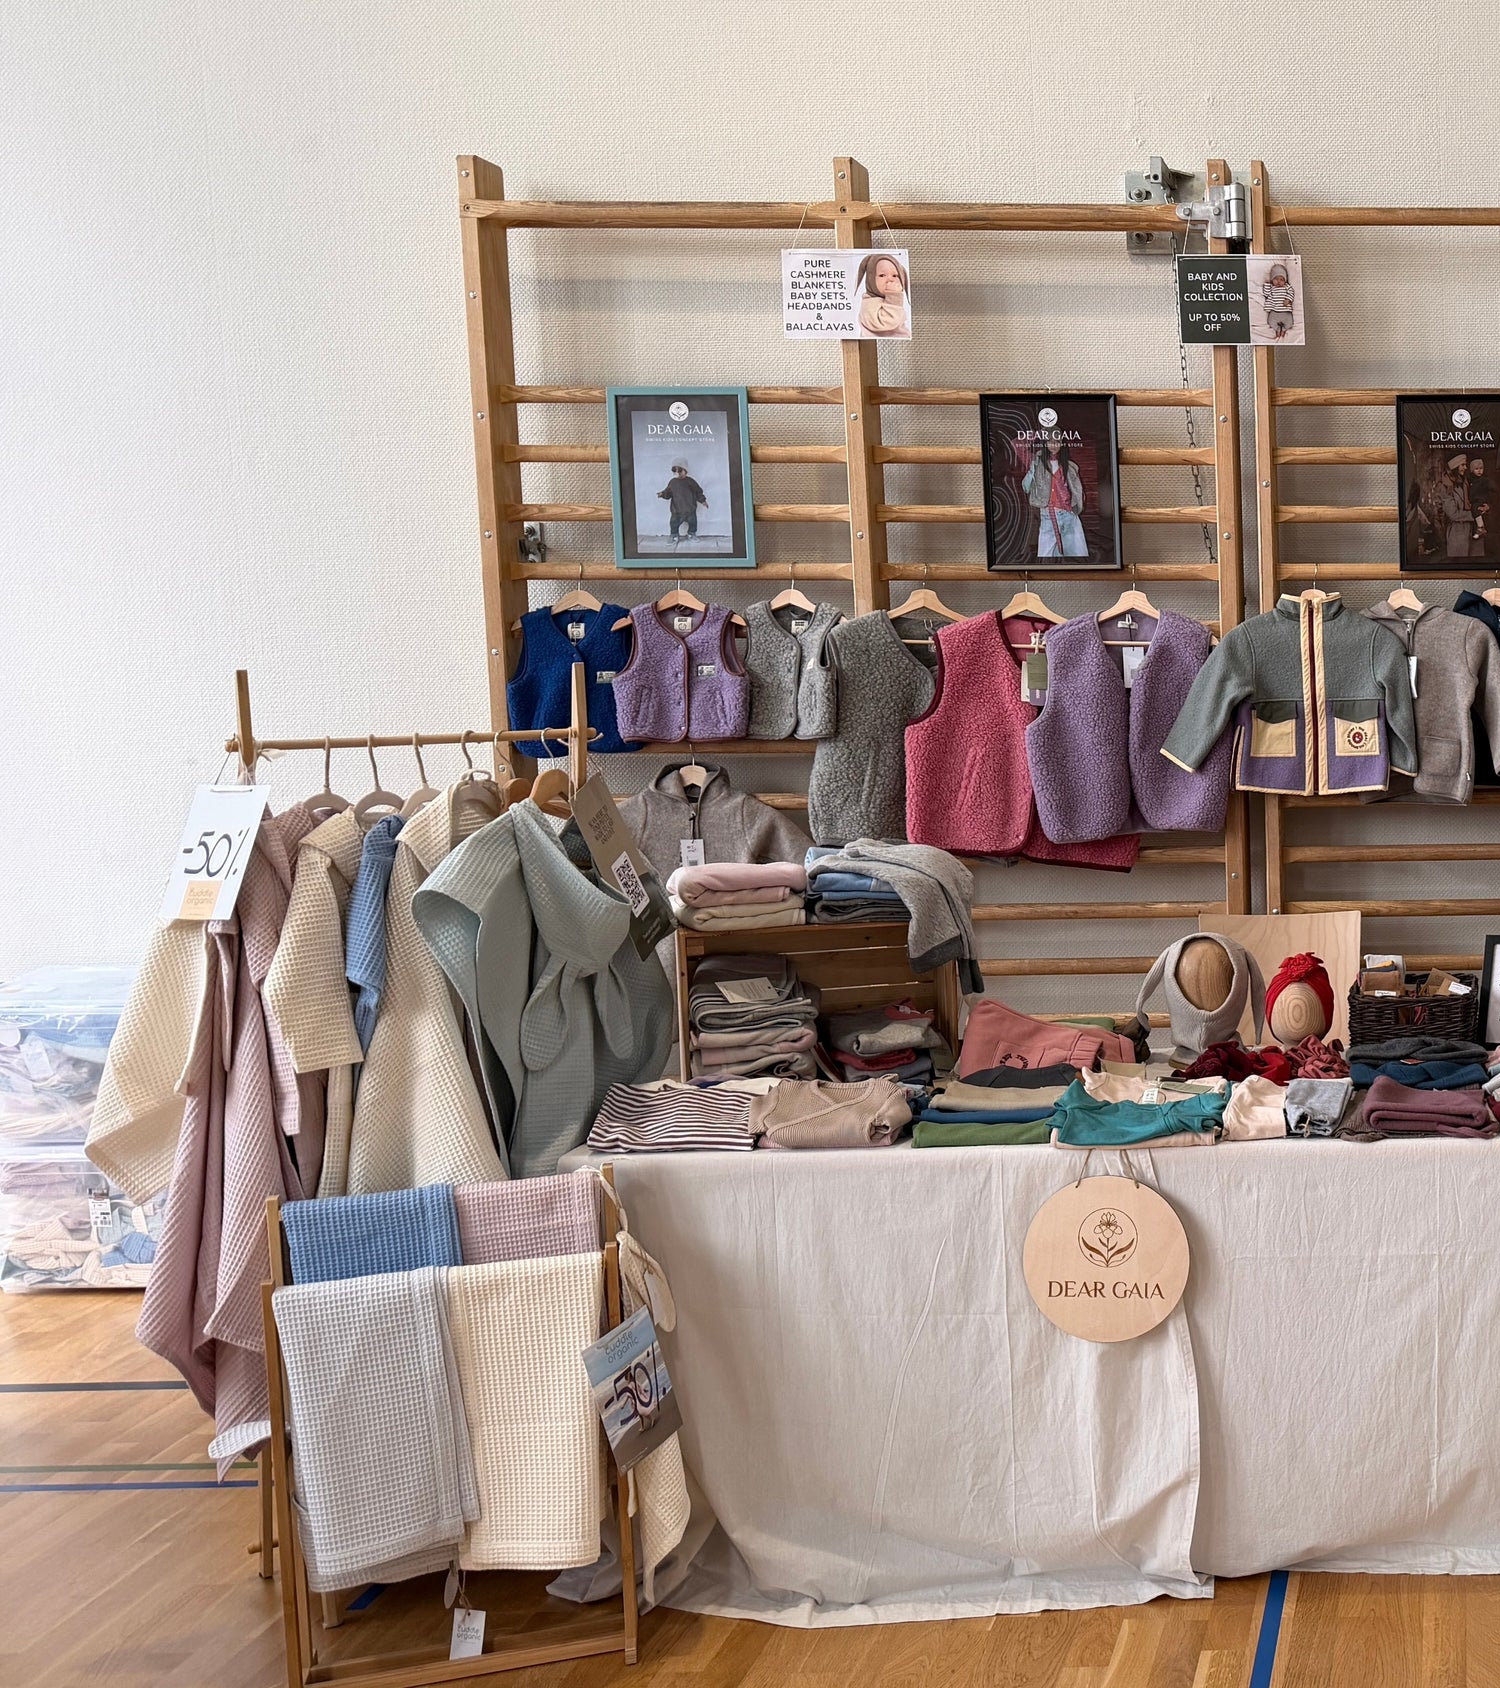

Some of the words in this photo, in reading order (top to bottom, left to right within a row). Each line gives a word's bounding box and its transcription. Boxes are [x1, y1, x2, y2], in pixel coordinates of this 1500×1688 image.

[804, 259, 831, 268] PURE
[790, 271, 846, 279] CASHMERE
[1188, 273, 1214, 281] BABY
[1216, 273, 1237, 281] AND
[791, 282, 847, 290] BLANKETS,
[1202, 283, 1225, 291] KIDS
[790, 292, 817, 300] BABY
[820, 292, 848, 300] SETS,
[1184, 293, 1243, 301] COLLECTION
[788, 302, 852, 311] HEADBANDS
[816, 313, 823, 321] &
[1189, 314, 1202, 322] UP
[1205, 314, 1218, 322] TO
[1221, 314, 1241, 322] 50%
[786, 323, 854, 331] BALACLAVAS
[1204, 324, 1222, 332] OFF
[648, 425, 680, 435] DEAR
[683, 424, 713, 435] GAIA
[1017, 431, 1049, 441] DEAR
[1052, 430, 1082, 441] GAIA
[1431, 432, 1463, 442] DEAR
[1465, 431, 1494, 442] GAIA
[182, 828, 250, 880] -50%
[1048, 1281, 1106, 1298] DEAR
[1112, 1281, 1165, 1299] GAIA
[605, 1331, 633, 1355] cuddle
[608, 1336, 639, 1364] organic
[456, 1632, 481, 1641] organic
